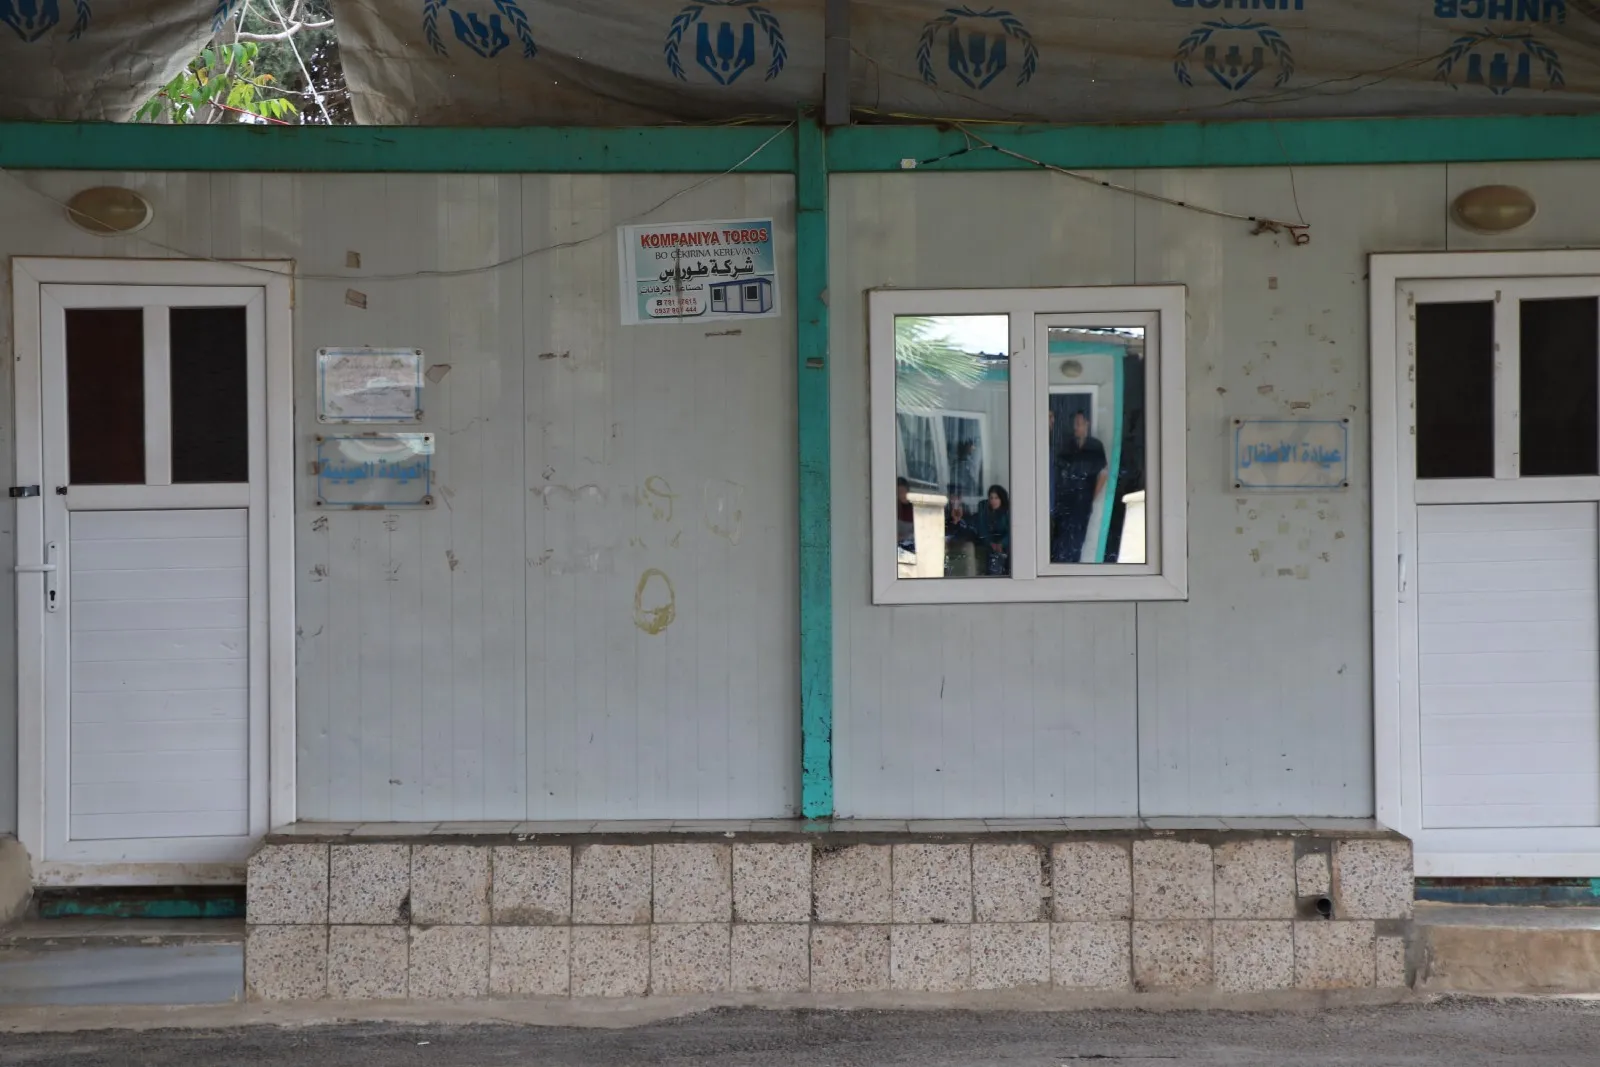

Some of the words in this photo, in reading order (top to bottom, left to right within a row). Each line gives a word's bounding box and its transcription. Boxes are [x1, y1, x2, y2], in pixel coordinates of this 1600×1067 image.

[641, 231, 720, 248] KOMPANIYA
[723, 228, 768, 244] TOROS
[655, 251, 668, 260] BO
[713, 247, 761, 257] KEREVANA
[660, 261, 709, 282] طورس
[711, 256, 755, 278] شركة
